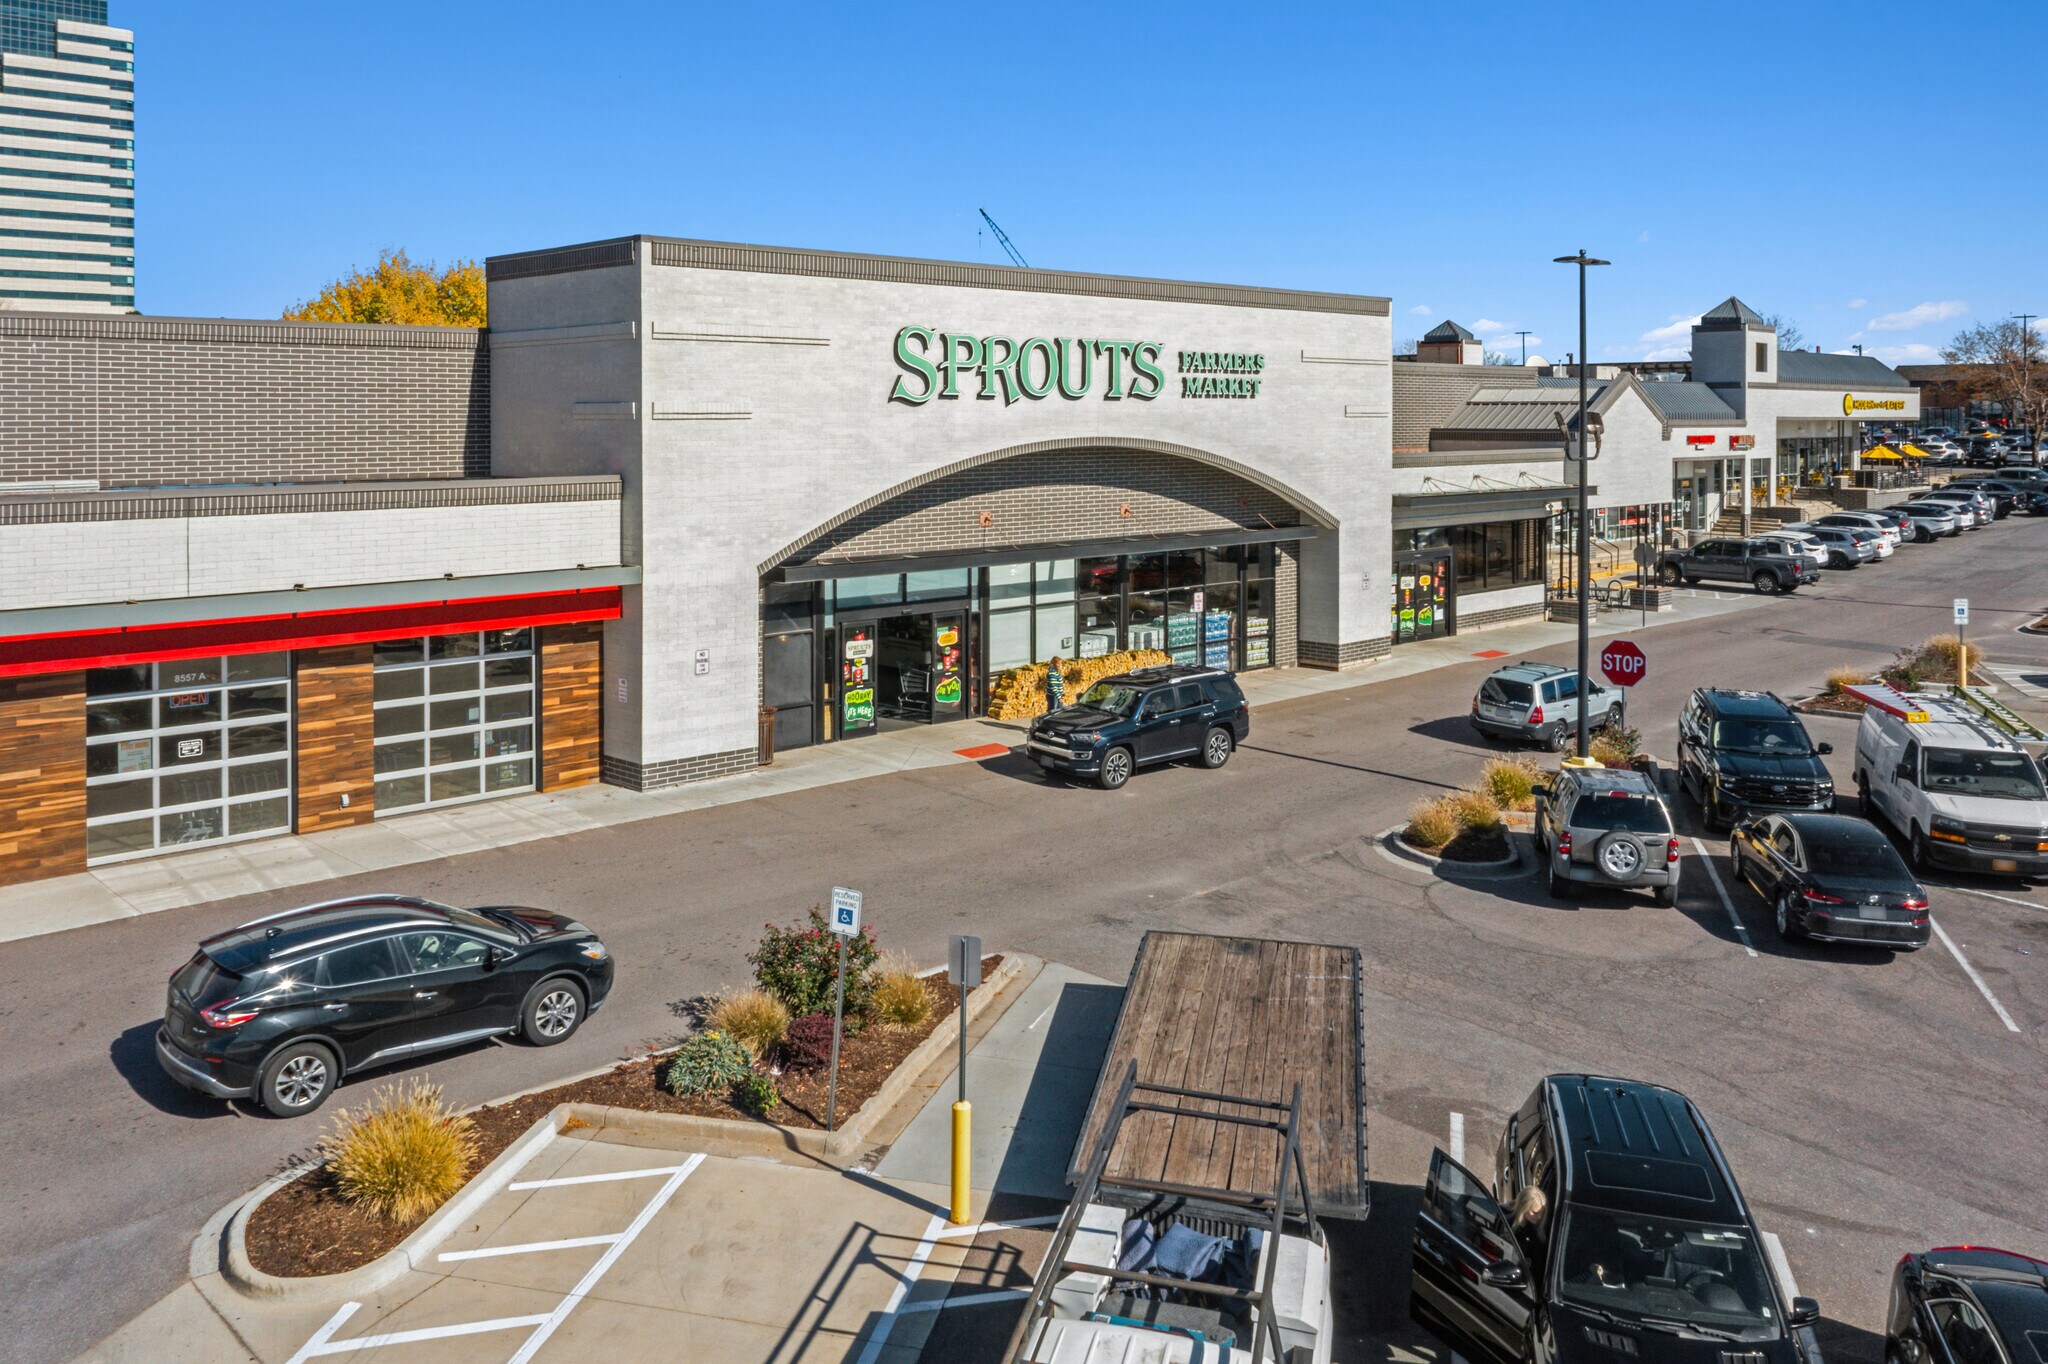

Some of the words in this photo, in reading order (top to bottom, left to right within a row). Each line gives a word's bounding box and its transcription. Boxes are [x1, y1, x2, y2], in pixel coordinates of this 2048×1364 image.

[888, 325, 1165, 407] SPROUTS
[1179, 351, 1266, 374] FARMERS
[1182, 376, 1263, 399] MARKET
[1603, 653, 1643, 673] STOP
[174, 673, 197, 683] 8557
[198, 672, 206, 681] A
[171, 692, 207, 706] OPEN
[857, 706, 872, 717] HERE
[835, 899, 857, 909] PARKING
